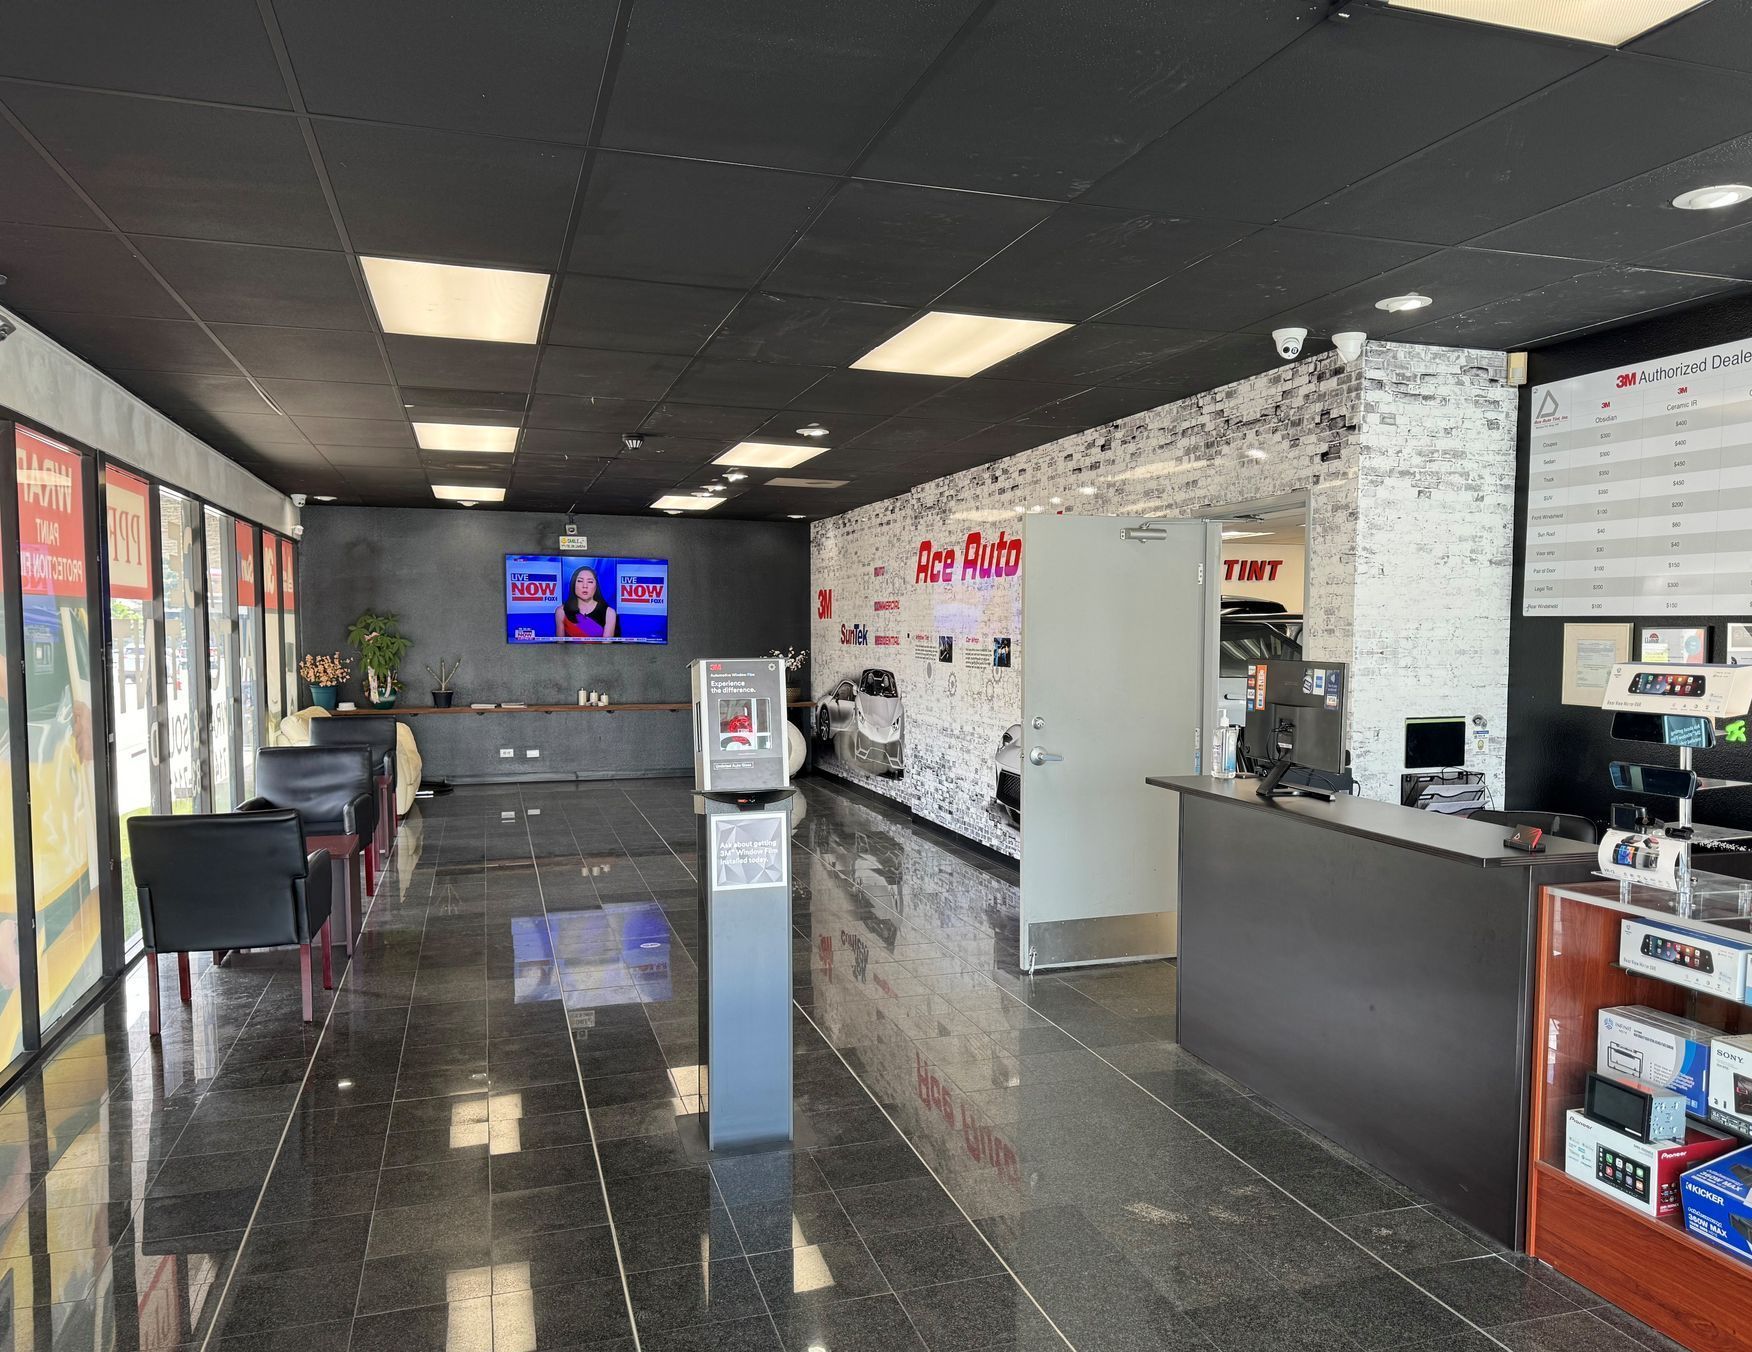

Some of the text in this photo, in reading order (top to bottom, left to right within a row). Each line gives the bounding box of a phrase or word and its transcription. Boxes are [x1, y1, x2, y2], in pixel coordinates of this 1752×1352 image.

[1616, 372, 1637, 388] 3M
[1639, 357, 1707, 383] Authorized
[1677, 387, 1688, 395] 3M
[1666, 399, 1698, 411] Ceramic IR
[1595, 415, 1618, 424] Obsidian
[1674, 439, 1686, 447] $400
[1673, 460, 1686, 468] $450
[1673, 479, 1685, 487] $450
[915, 531, 1022, 584] Ace Auto
[1223, 560, 1284, 581] TINT
[511, 573, 529, 581] LIVE
[511, 582, 557, 596] NOW
[621, 585, 664, 598] NOW
[818, 589, 833, 620] 3M
[840, 623, 868, 646] SunTek
[711, 680, 746, 688] Experience
[711, 686, 757, 694] the difference.
[753, 840, 777, 848] getting
[1716, 1048, 1745, 1064] SONY
[1569, 1116, 1593, 1130] Pioneer
[1661, 1150, 1687, 1160] Pioneer
[1691, 1184, 1725, 1206] KICKER
[1709, 1222, 1728, 1239] MAX
